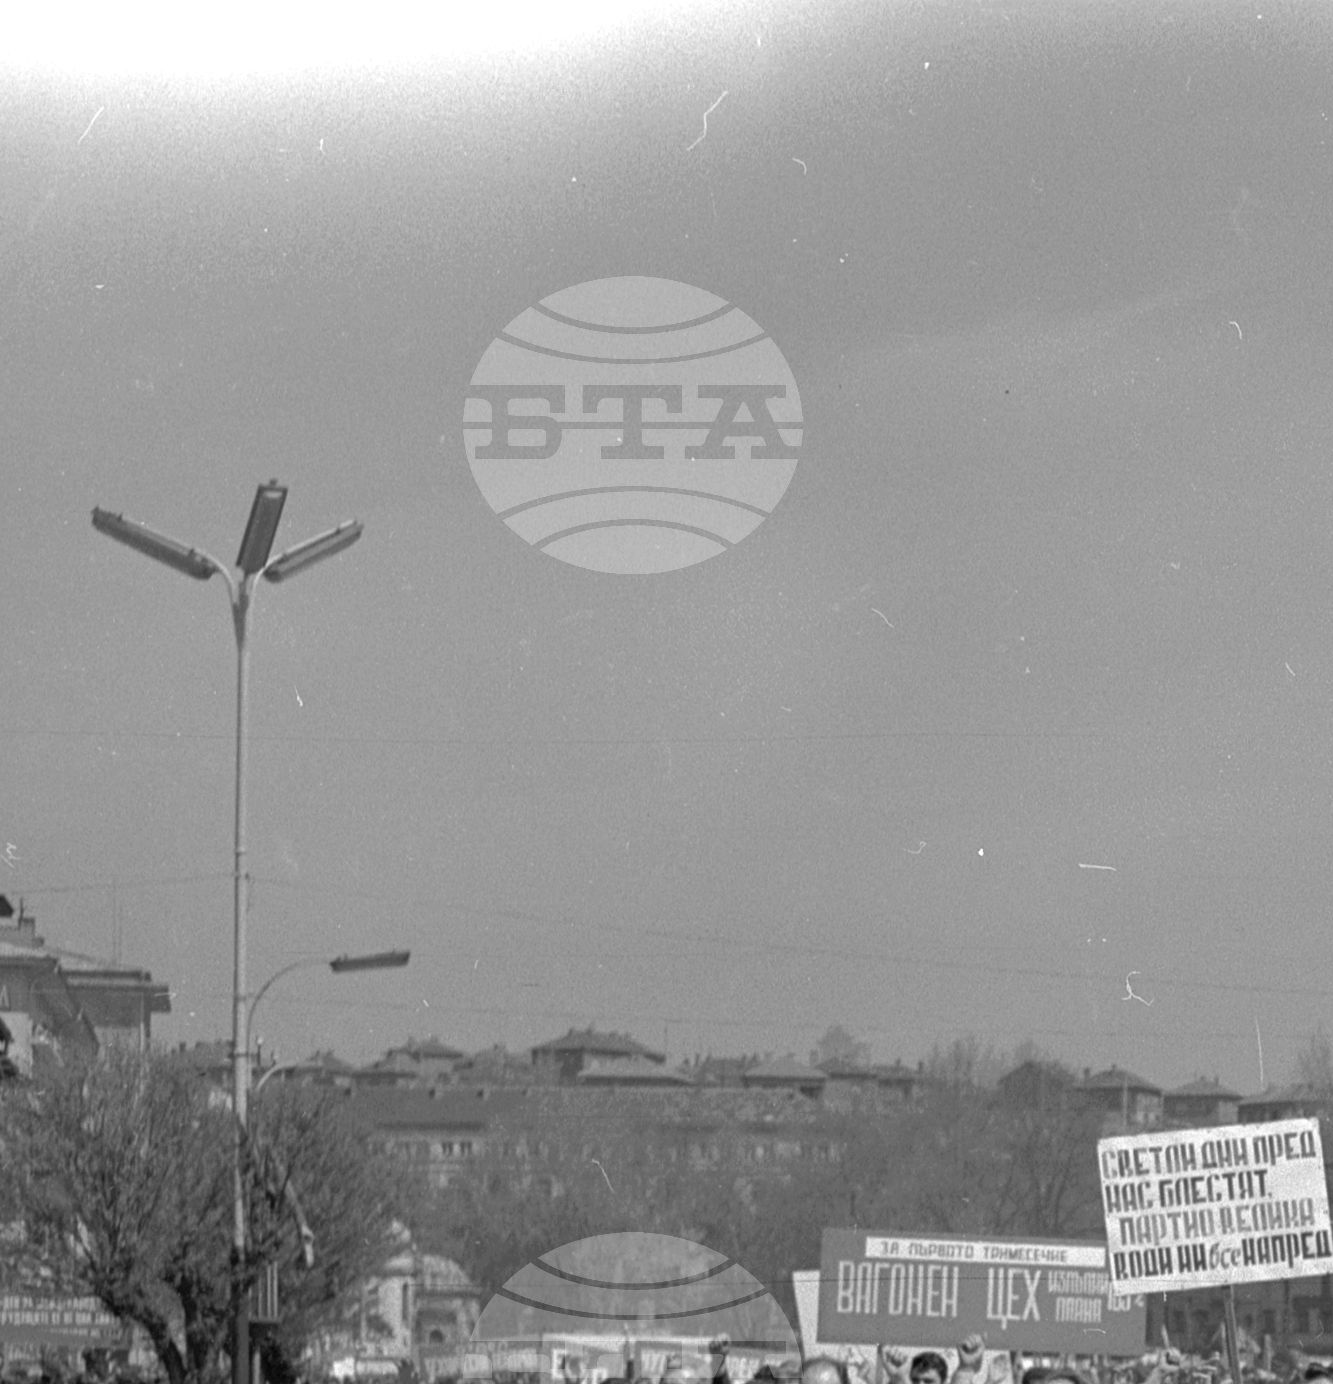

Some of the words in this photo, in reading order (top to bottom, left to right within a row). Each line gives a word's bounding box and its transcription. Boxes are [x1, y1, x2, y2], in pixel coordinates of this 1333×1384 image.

[1102, 1143, 1197, 1179] СВЕТЛИ
[1201, 1138, 1249, 1169] ДНИ
[1252, 1130, 1316, 1166] ПРЕД
[1105, 1181, 1153, 1213] НАС
[1219, 1198, 1316, 1235] ВЕЛИКА
[880, 1240, 899, 1255] ЗА
[908, 1242, 975, 1258] ПЪРВОТО
[983, 1244, 1068, 1263] ТРИМЕСЕЧИЕ
[1114, 1247, 1174, 1280] ВОДИ
[1177, 1243, 1207, 1273] НИ
[1242, 1230, 1333, 1269] НАПРЕД
[837, 1260, 959, 1318] ВАГОНЕН
[986, 1267, 1041, 1330] ЦЕХ
[1056, 1297, 1101, 1322] ПЛАНА
